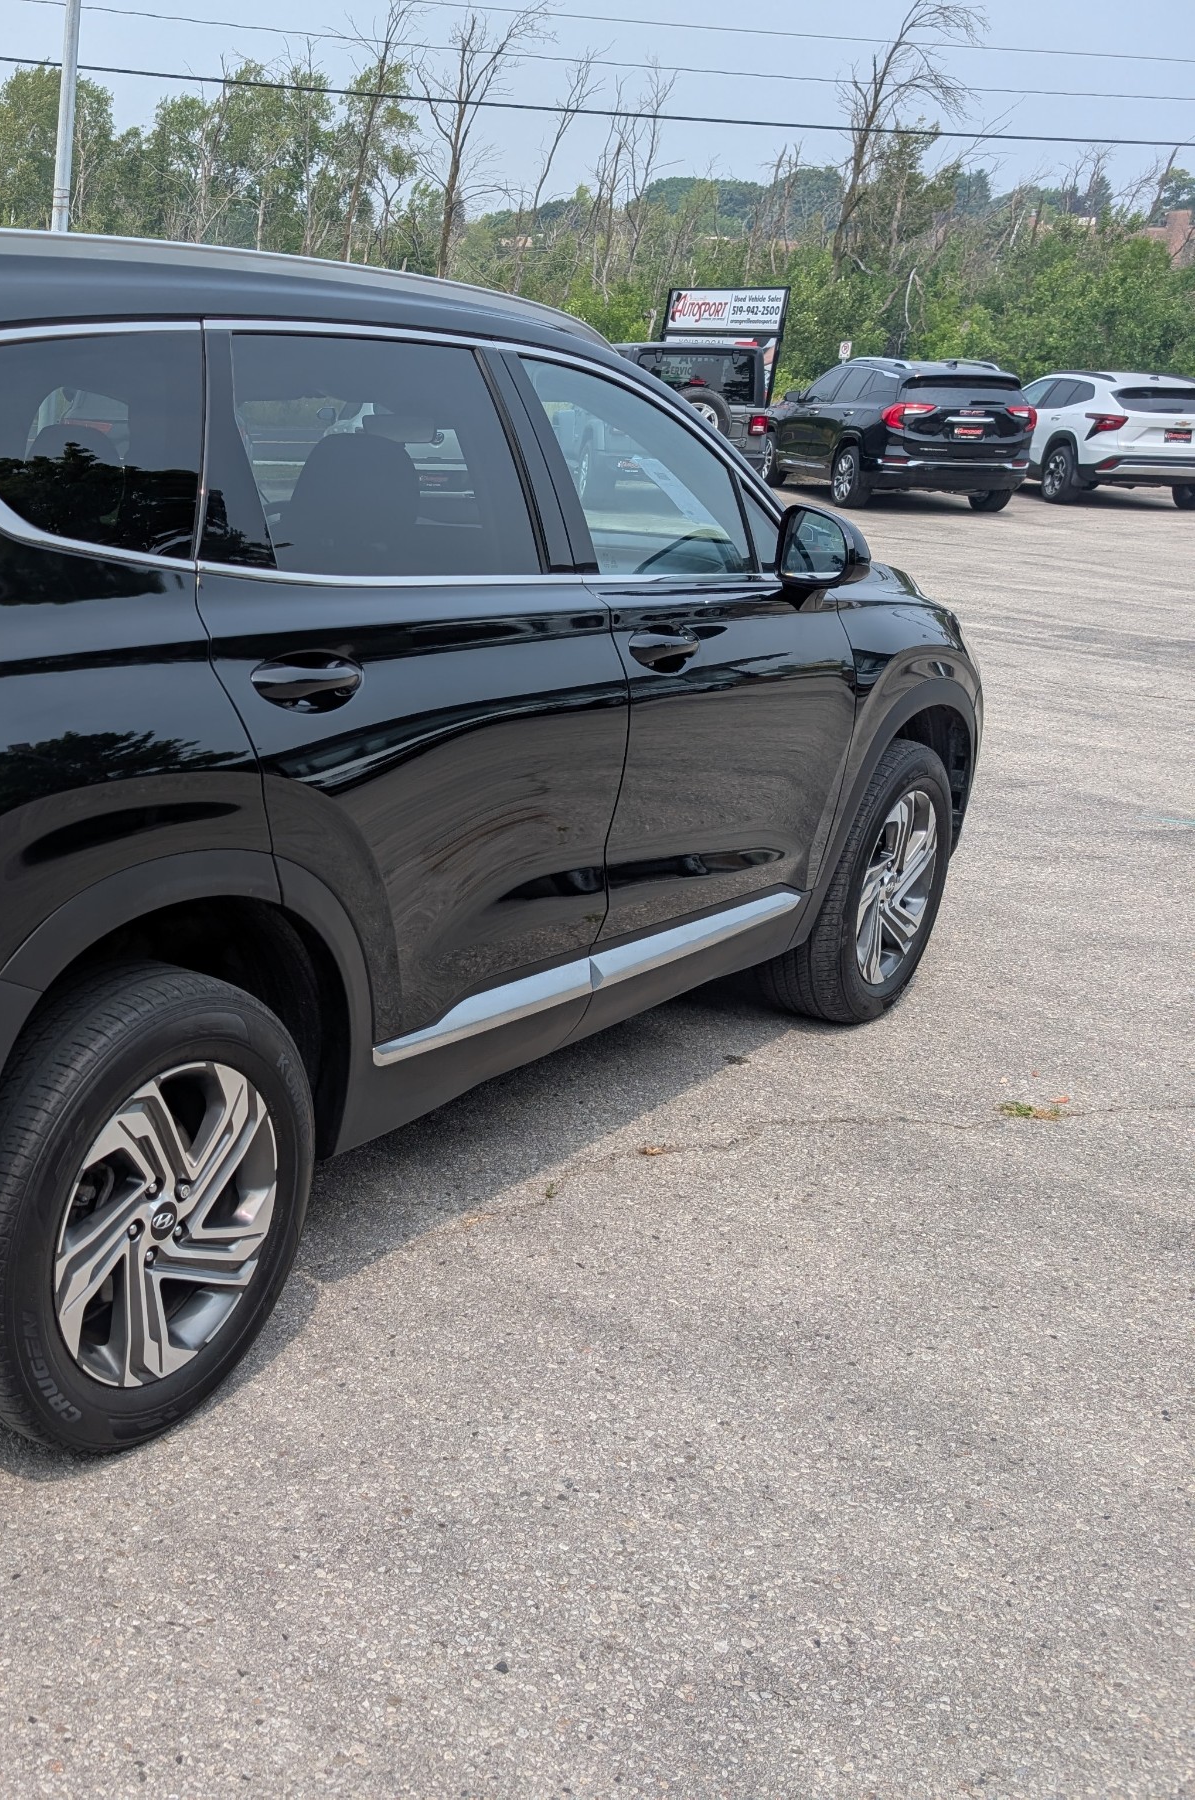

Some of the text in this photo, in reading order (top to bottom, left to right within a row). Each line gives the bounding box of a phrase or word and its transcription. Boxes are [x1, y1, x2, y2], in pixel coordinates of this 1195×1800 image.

[748, 294, 766, 302] Vehicle
[767, 294, 782, 302] Sales
[731, 305, 780, 316] 519-942-2500
[21, 1311, 82, 1423] CRUGEN
